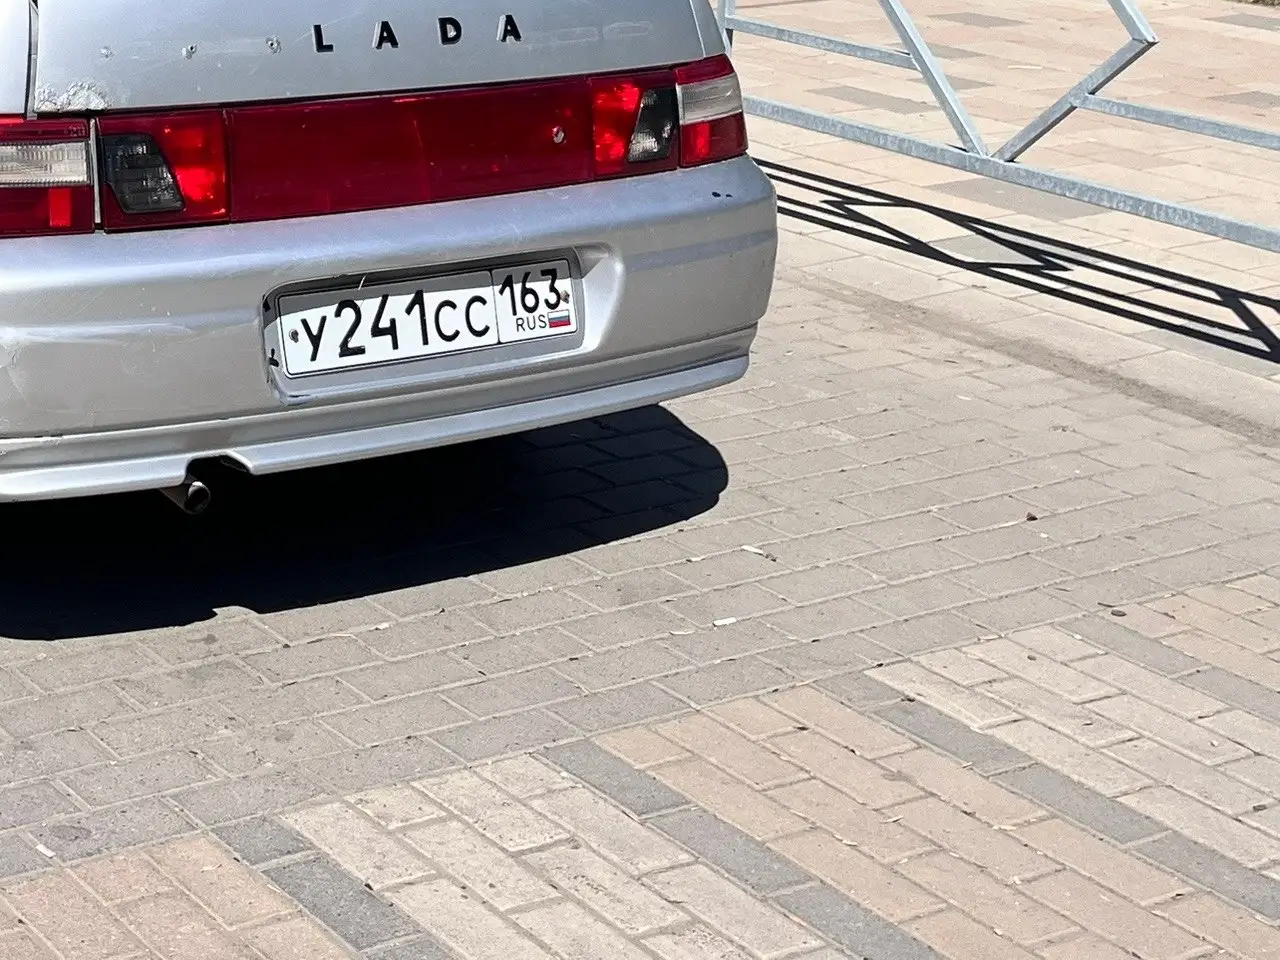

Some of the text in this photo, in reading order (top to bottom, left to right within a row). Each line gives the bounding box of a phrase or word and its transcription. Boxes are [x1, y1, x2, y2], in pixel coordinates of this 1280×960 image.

[313, 14, 521, 53] LADA
[300, 267, 561, 362] У241СС 163
[516, 315, 547, 332] RUS
